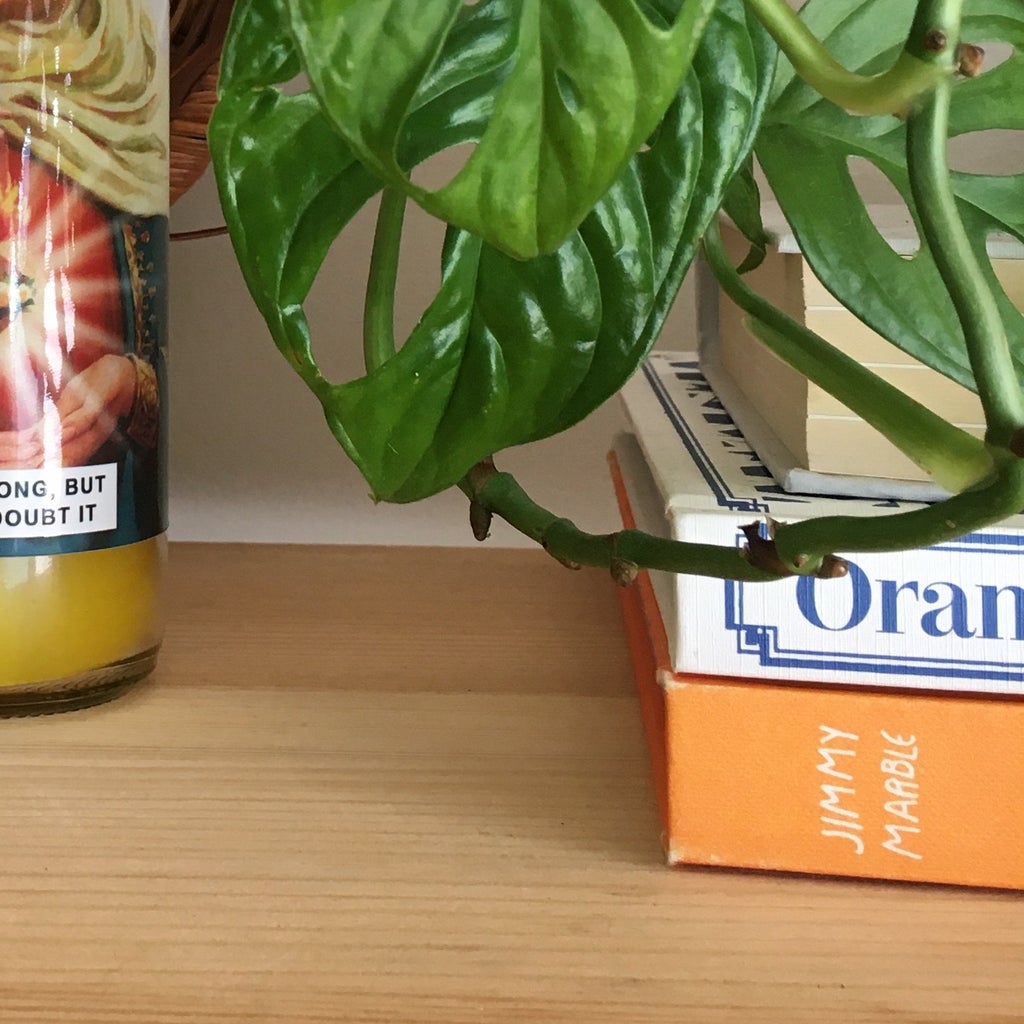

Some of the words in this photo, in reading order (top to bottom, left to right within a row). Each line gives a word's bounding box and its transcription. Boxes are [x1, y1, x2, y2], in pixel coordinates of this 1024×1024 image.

[64, 474, 107, 496] BUT
[79, 503, 97, 524] IT
[816, 725, 865, 855] JIMMY
[880, 729, 922, 860] MARBLE
